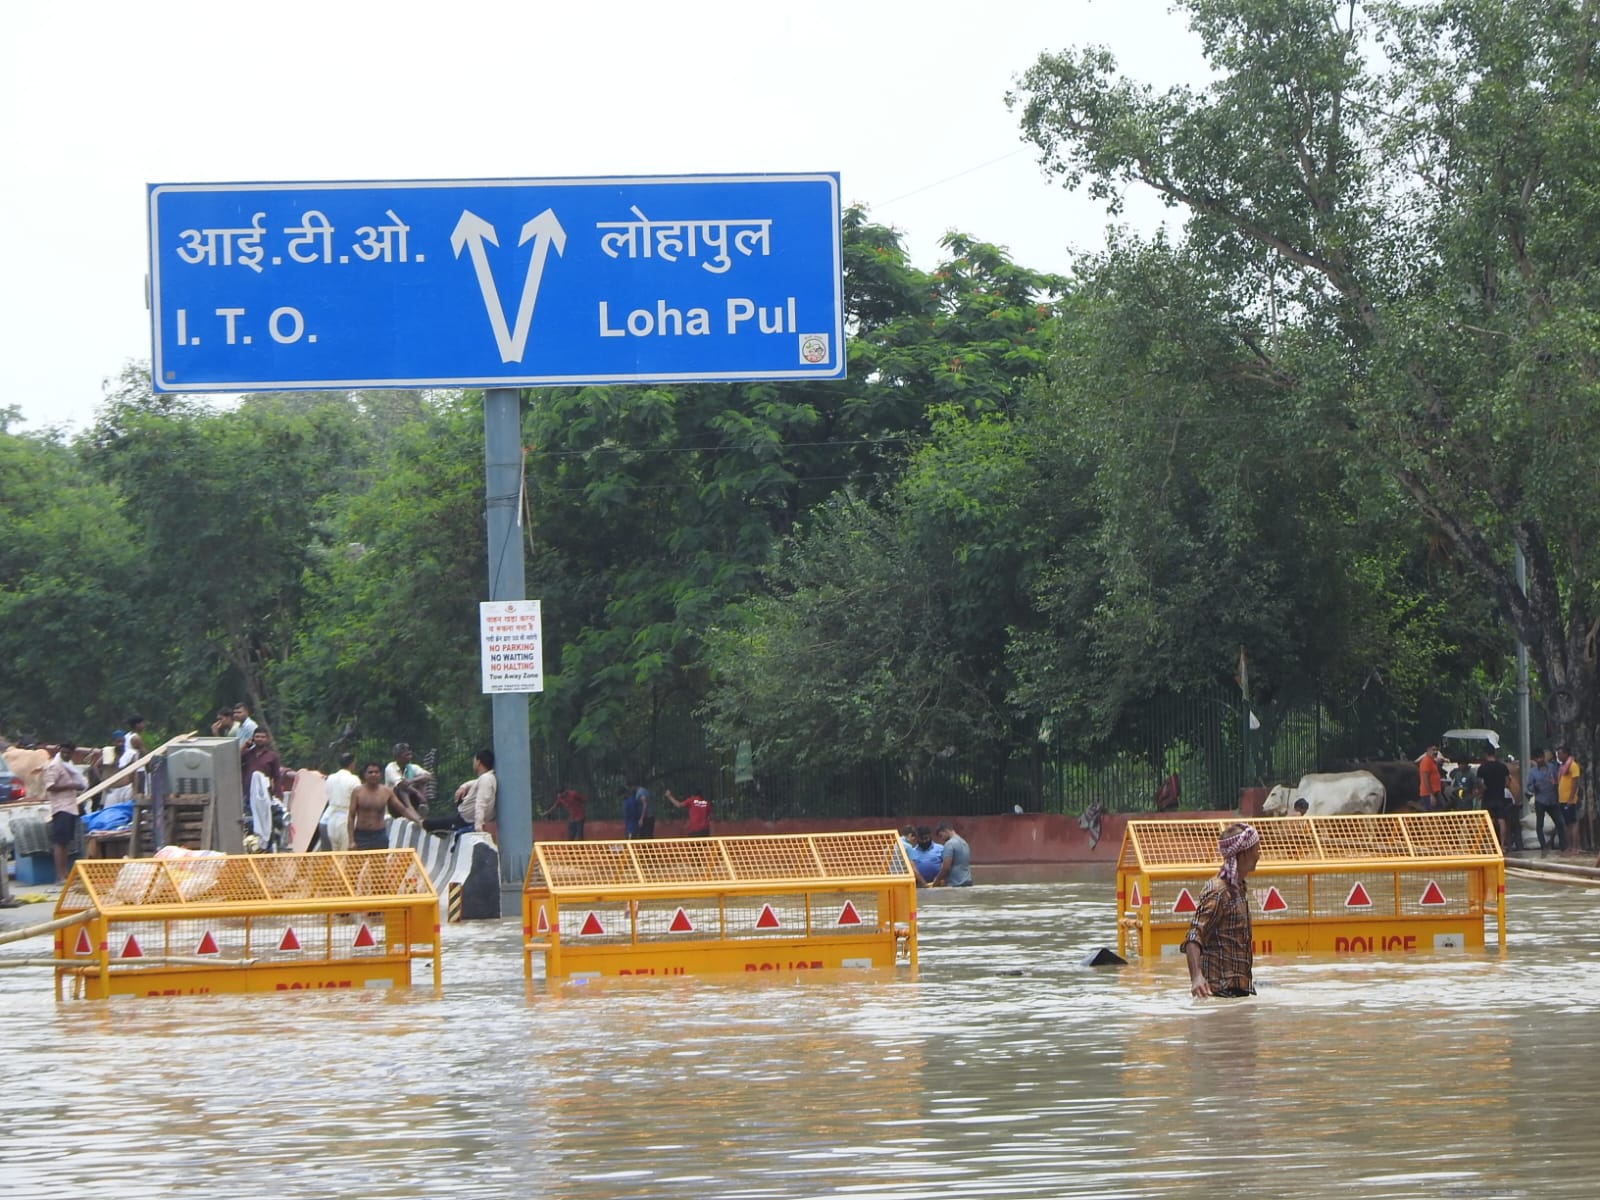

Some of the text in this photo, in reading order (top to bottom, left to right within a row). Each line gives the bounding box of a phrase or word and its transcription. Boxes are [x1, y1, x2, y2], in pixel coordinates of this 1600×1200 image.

[176, 209, 425, 273] आई.टी.ओ.
[596, 205, 773, 274] लोहापुल
[599, 297, 796, 337] Loha Pul
[490, 653, 534, 662] NO WAITING
[502, 643, 535, 651] PARKING
[490, 662, 535, 671] NO HALTING
